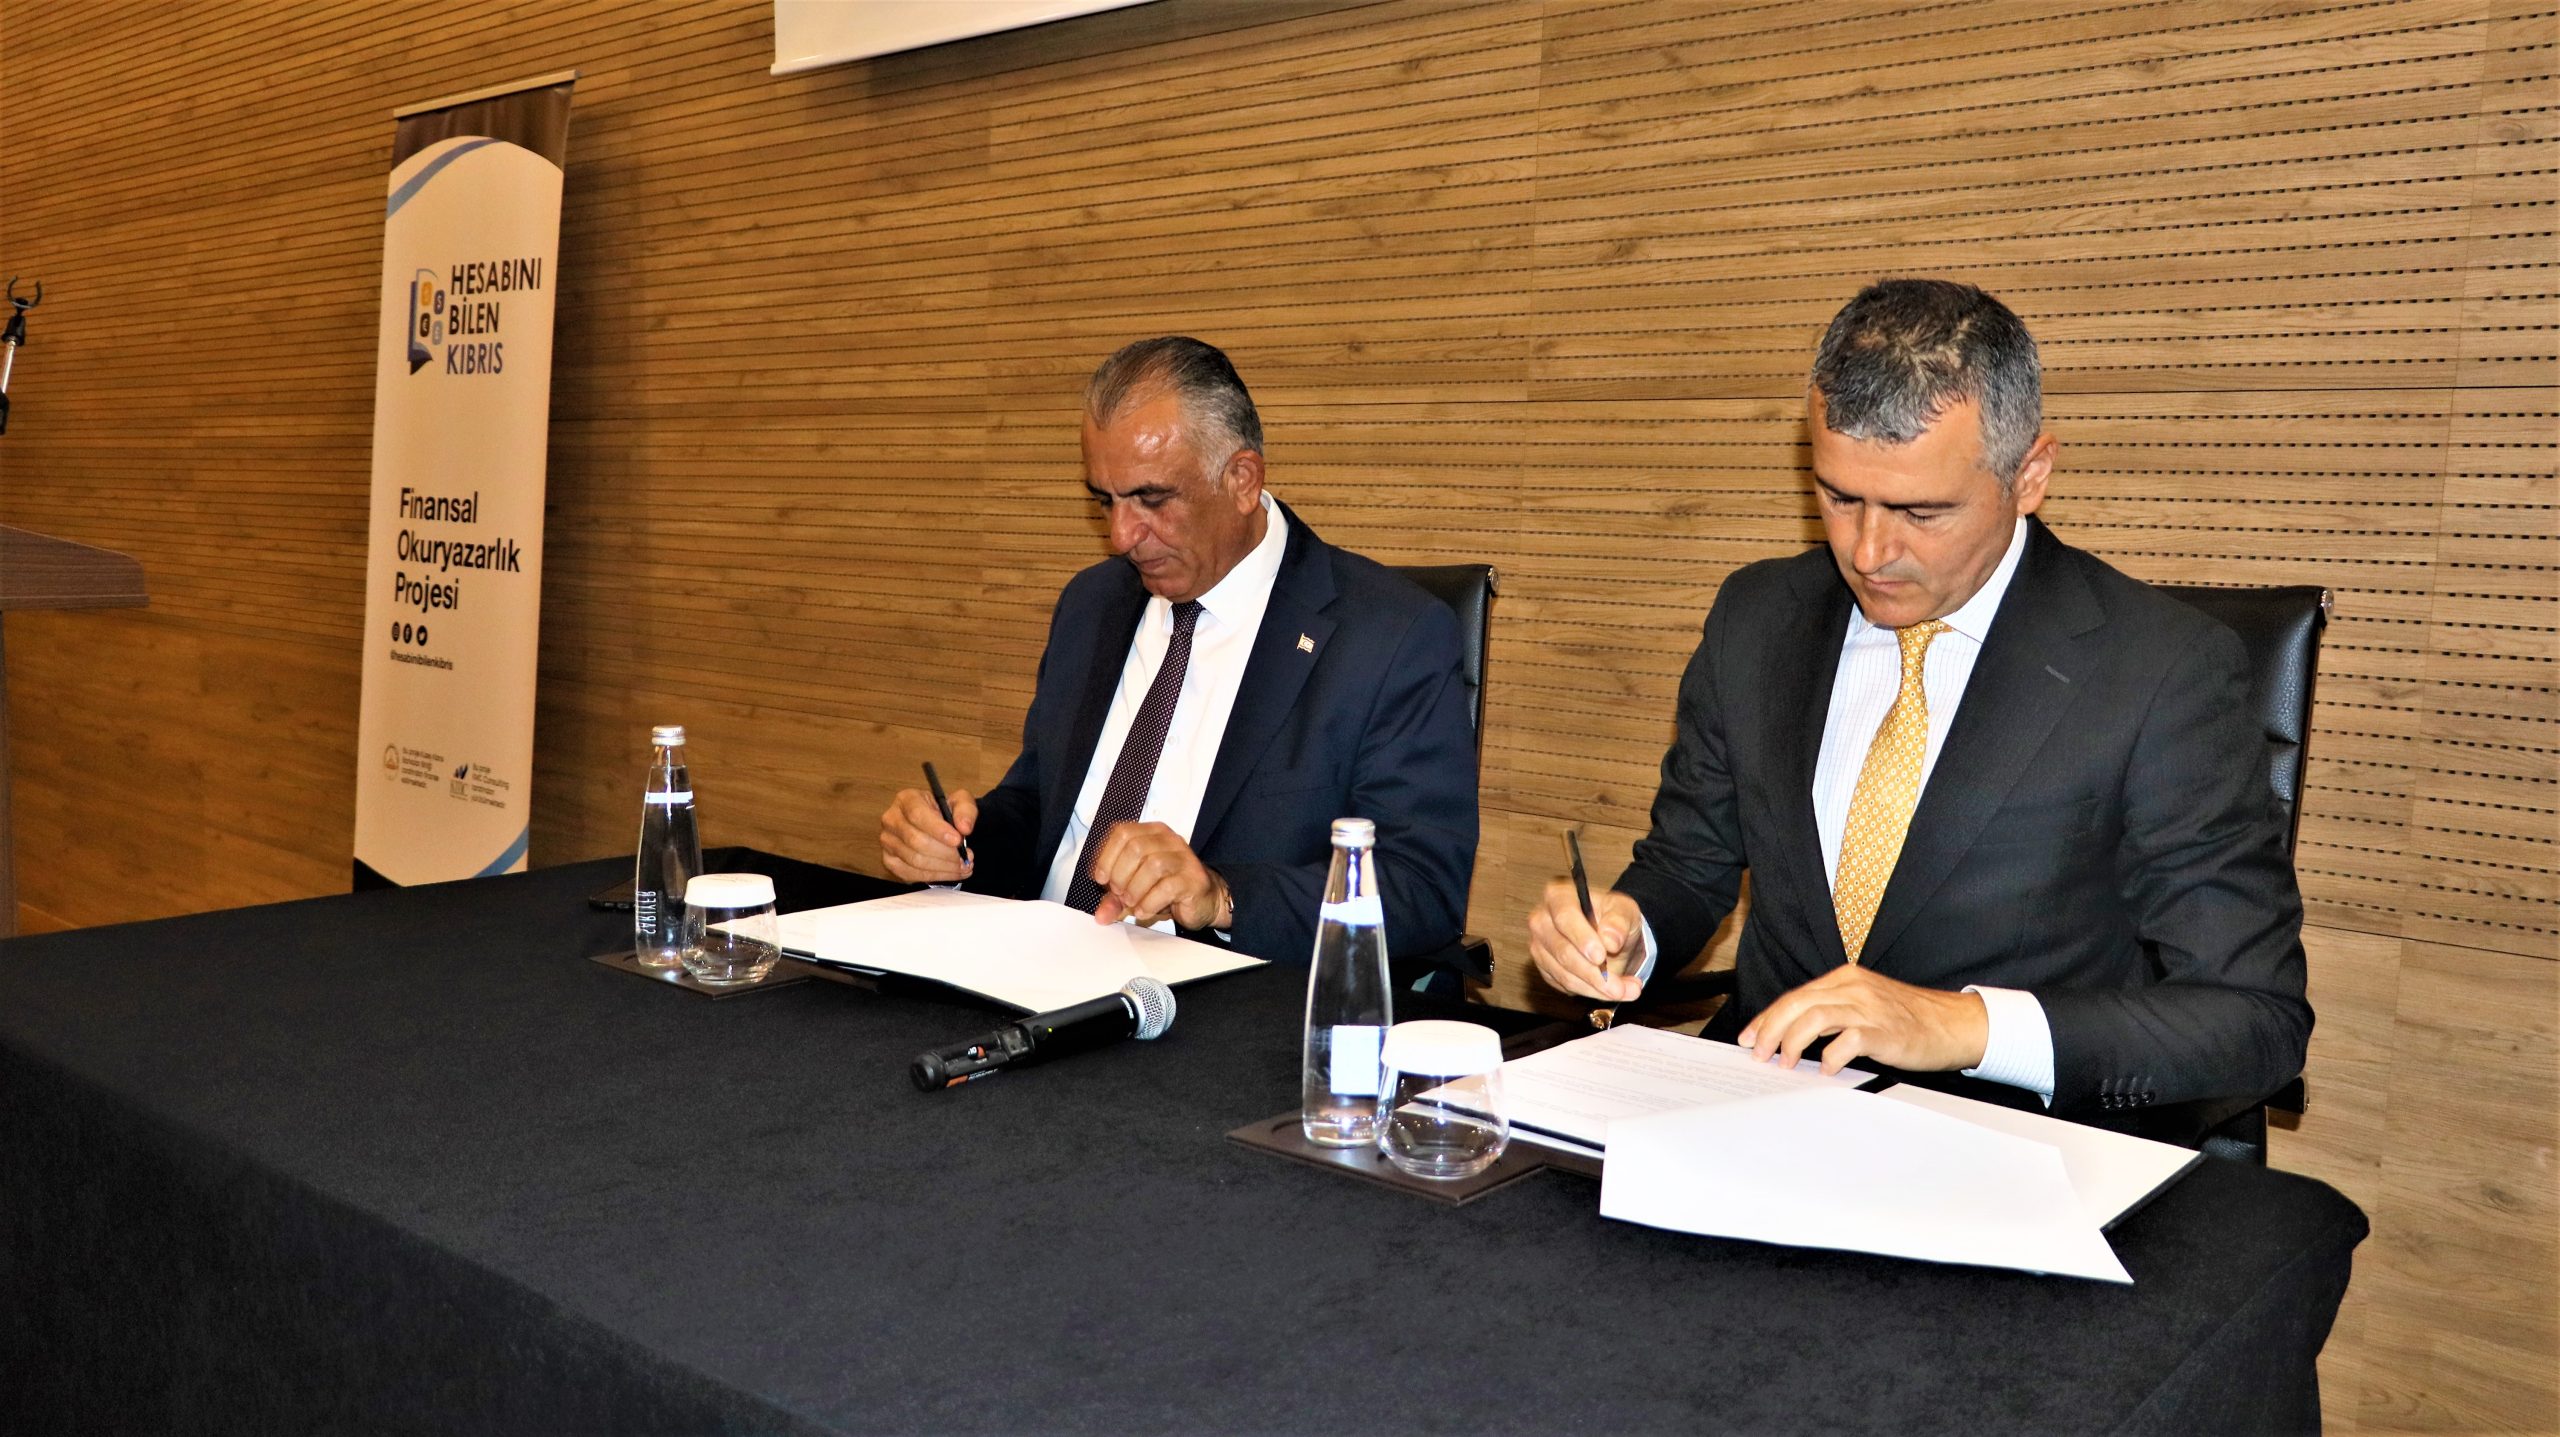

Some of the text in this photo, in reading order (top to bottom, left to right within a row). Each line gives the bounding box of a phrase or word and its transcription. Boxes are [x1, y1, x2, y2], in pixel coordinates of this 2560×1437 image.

[450, 257, 542, 295] HESABINI
[448, 297, 500, 335] BİLEN
[446, 342, 504, 375] KIBRIS
[400, 487, 478, 523] Finansal
[398, 529, 521, 573] Okuryazarlık
[394, 571, 459, 613] Projesi
